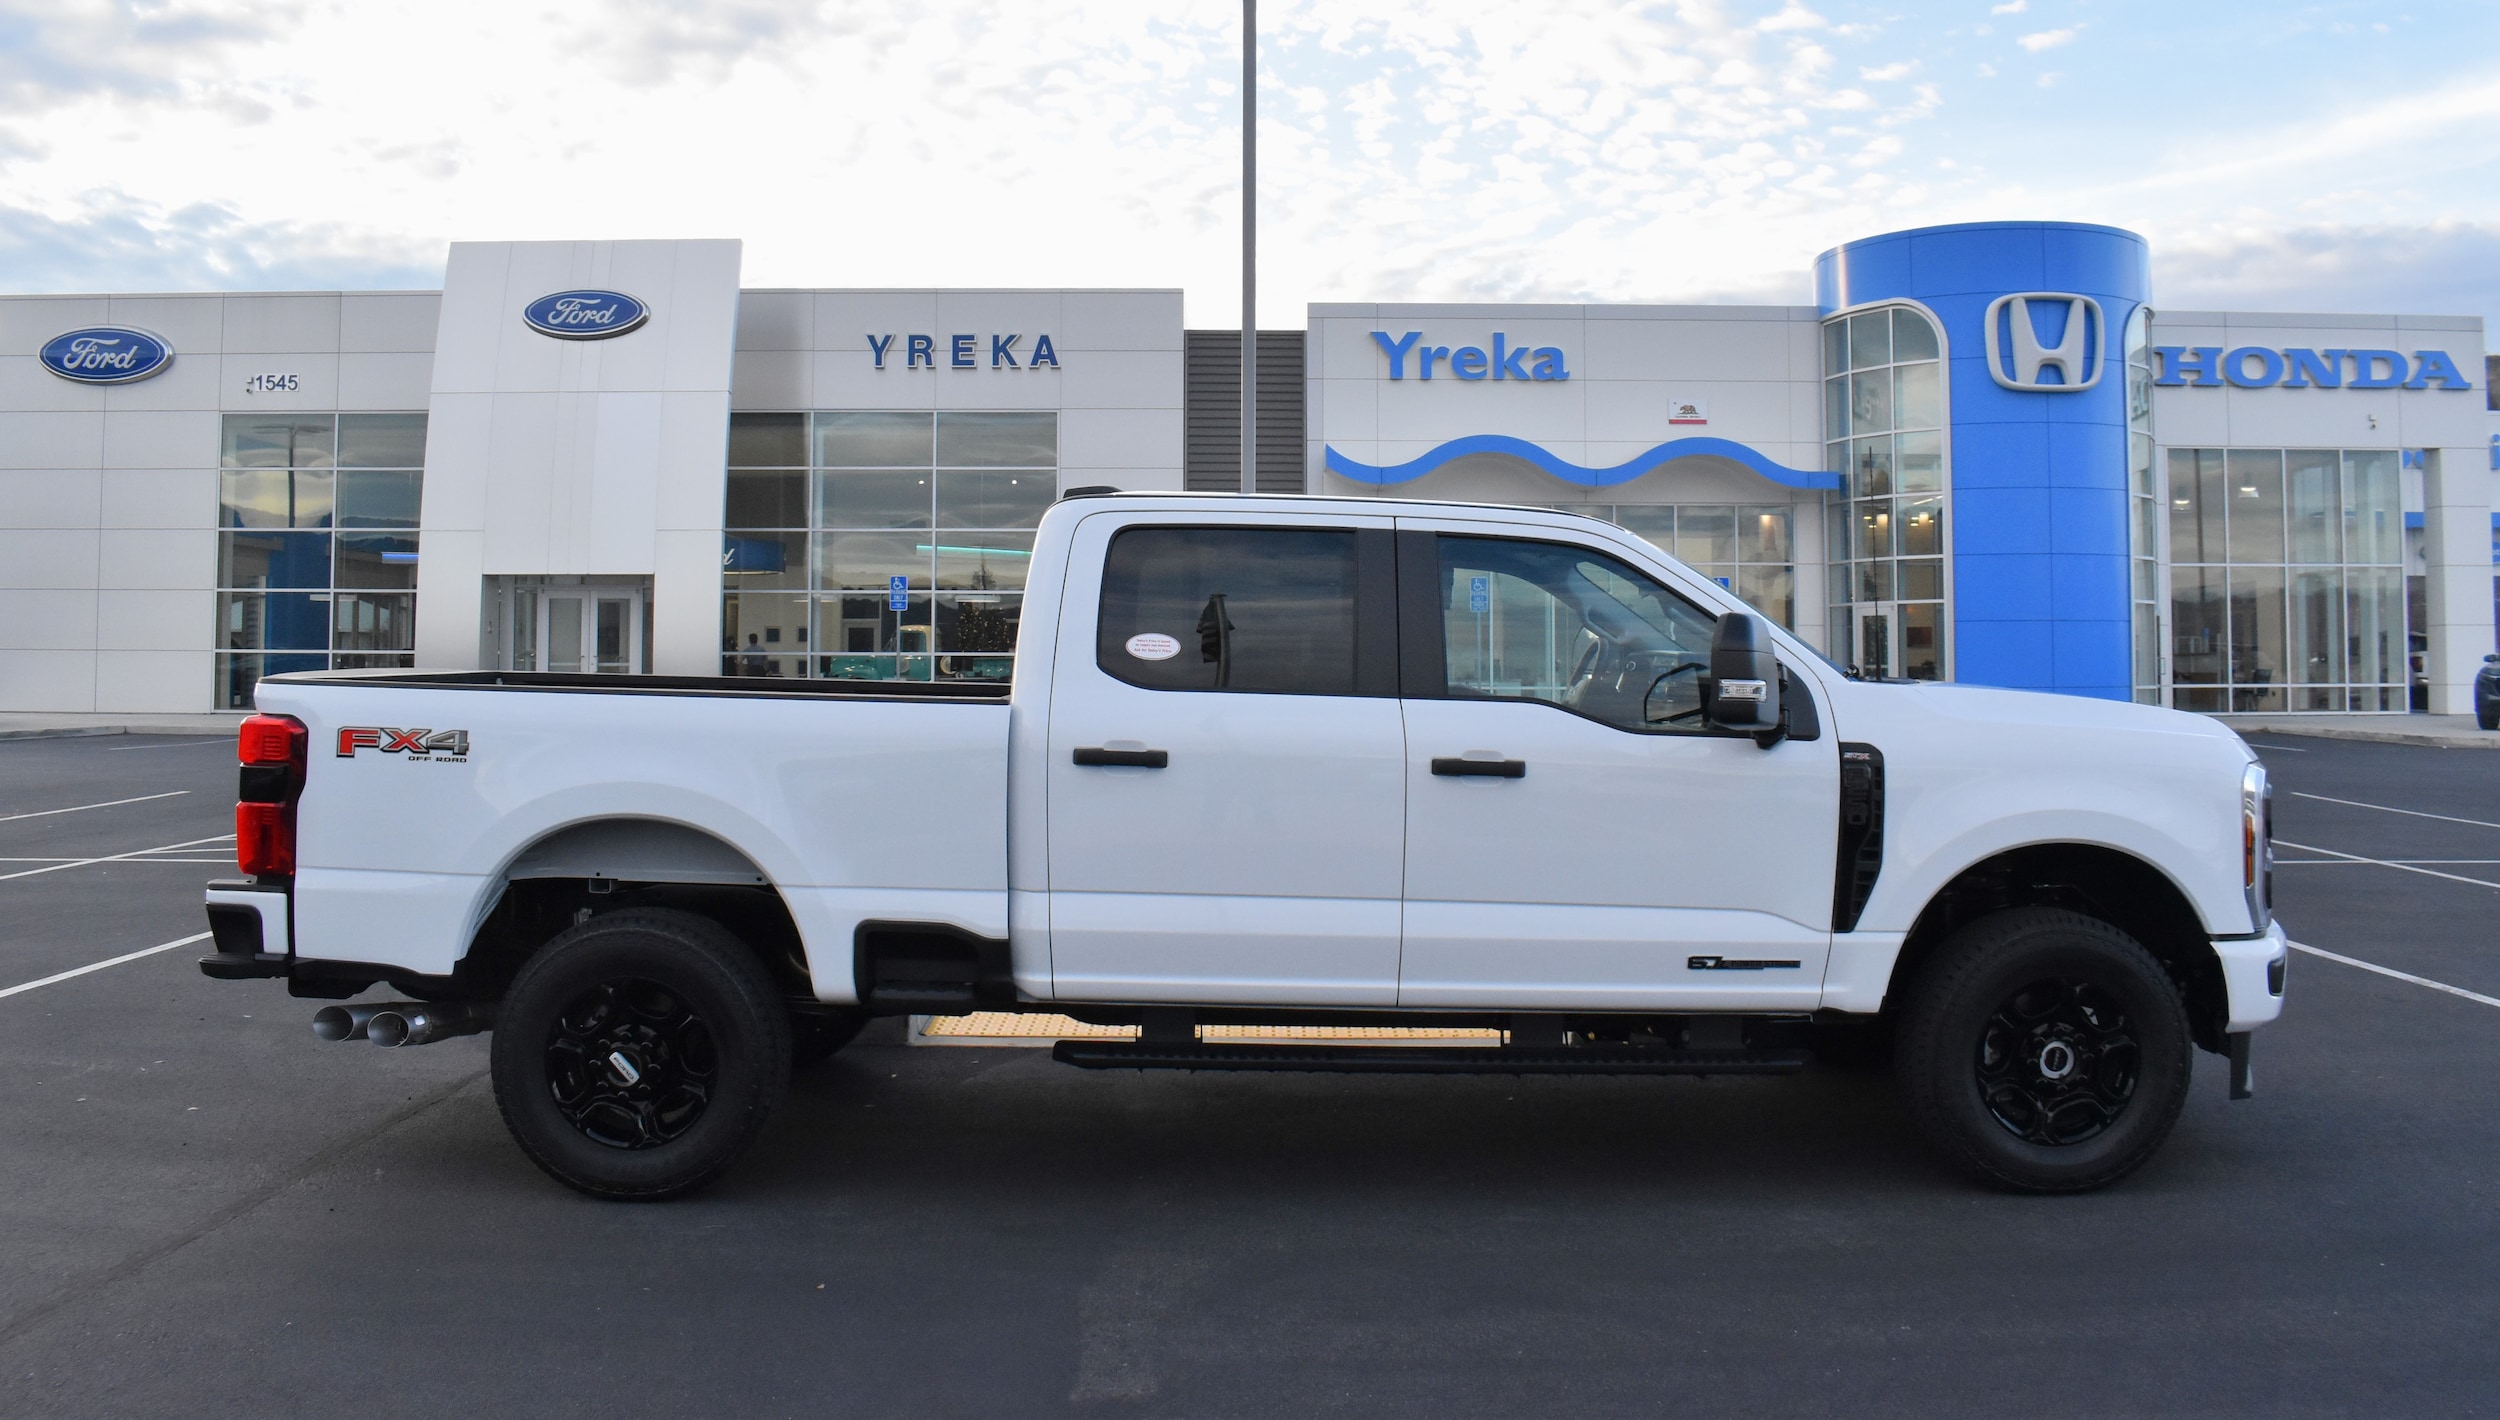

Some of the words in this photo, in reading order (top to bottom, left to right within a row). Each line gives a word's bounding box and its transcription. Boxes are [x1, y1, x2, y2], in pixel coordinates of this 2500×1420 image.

[547, 297, 618, 325] Ford
[63, 337, 139, 370] Ford
[866, 333, 1061, 369] YREKA
[1370, 331, 1570, 381] Yreka
[255, 374, 298, 391] 1545
[2154, 346, 2472, 390] HONDA
[336, 726, 469, 758] FX4
